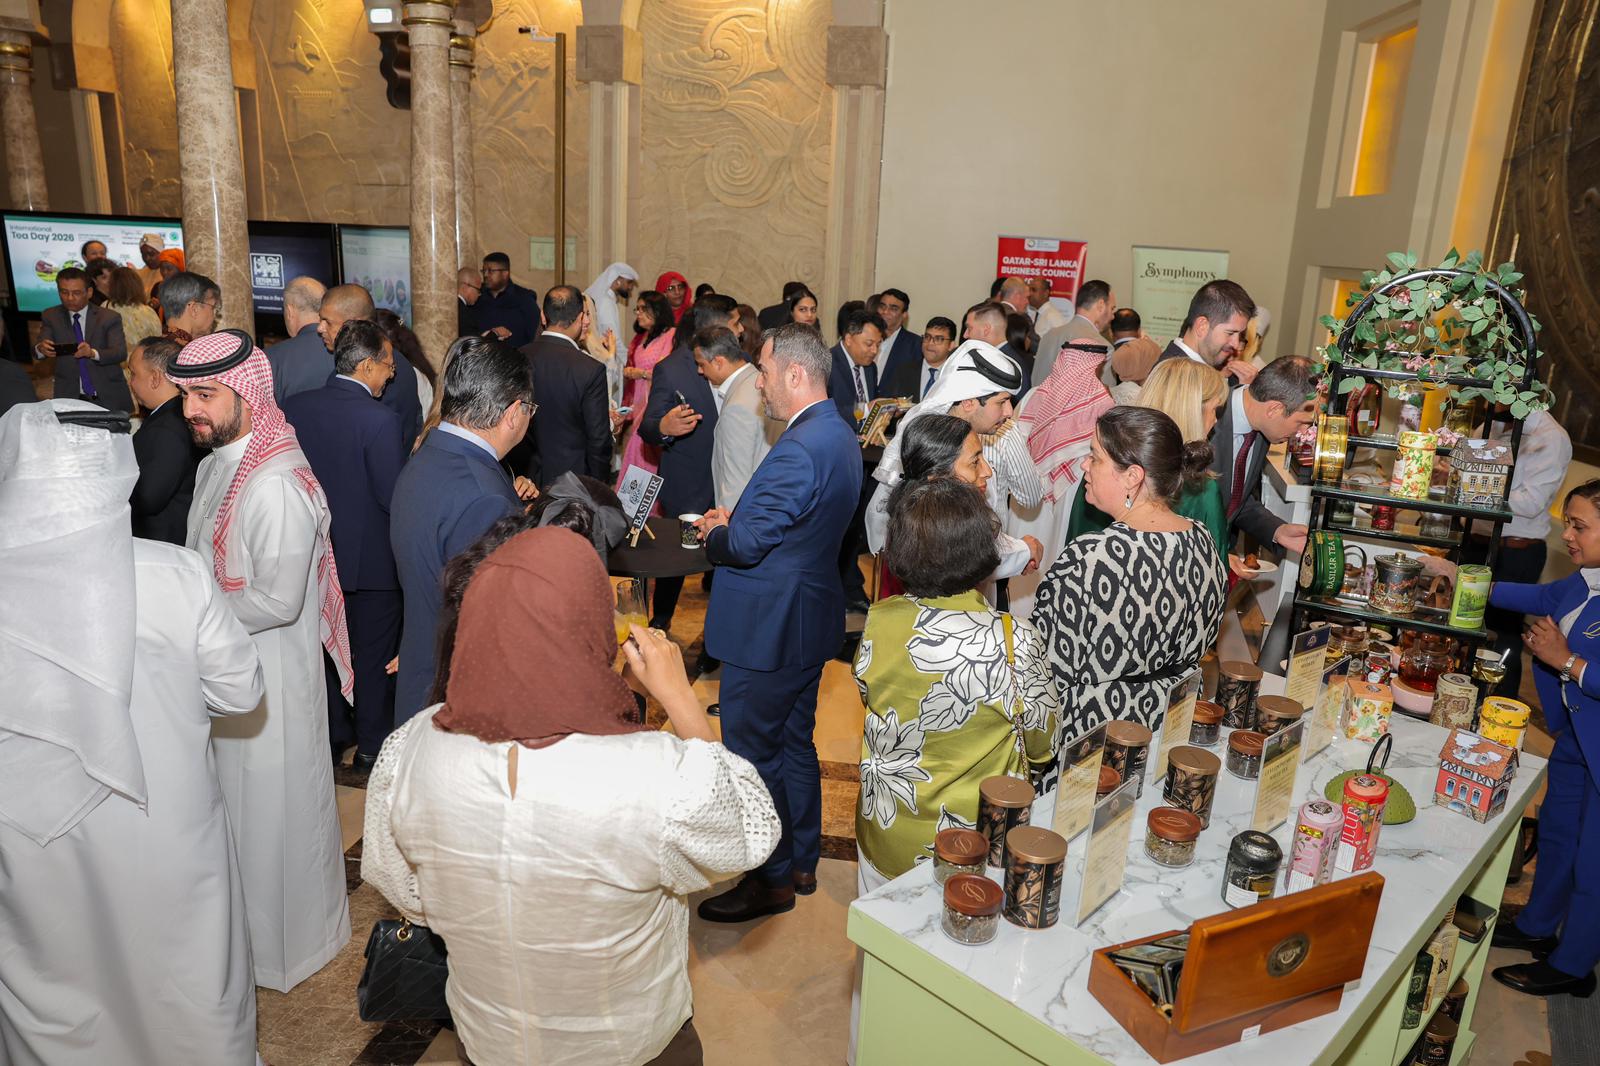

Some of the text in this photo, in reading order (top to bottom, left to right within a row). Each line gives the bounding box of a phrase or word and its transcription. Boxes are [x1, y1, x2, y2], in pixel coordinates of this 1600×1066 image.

[10, 224, 52, 232] International
[12, 231, 29, 240] Tea
[31, 232, 50, 243] Day
[52, 233, 75, 241] 2026
[1002, 256, 1078, 269] QATAR-SRI LANKA
[1001, 266, 1041, 276] BUSINESS
[1140, 262, 1217, 281] Symphonys
[633, 479, 660, 527] BASILUR
[1326, 541, 1337, 589] BASILUR TEA
